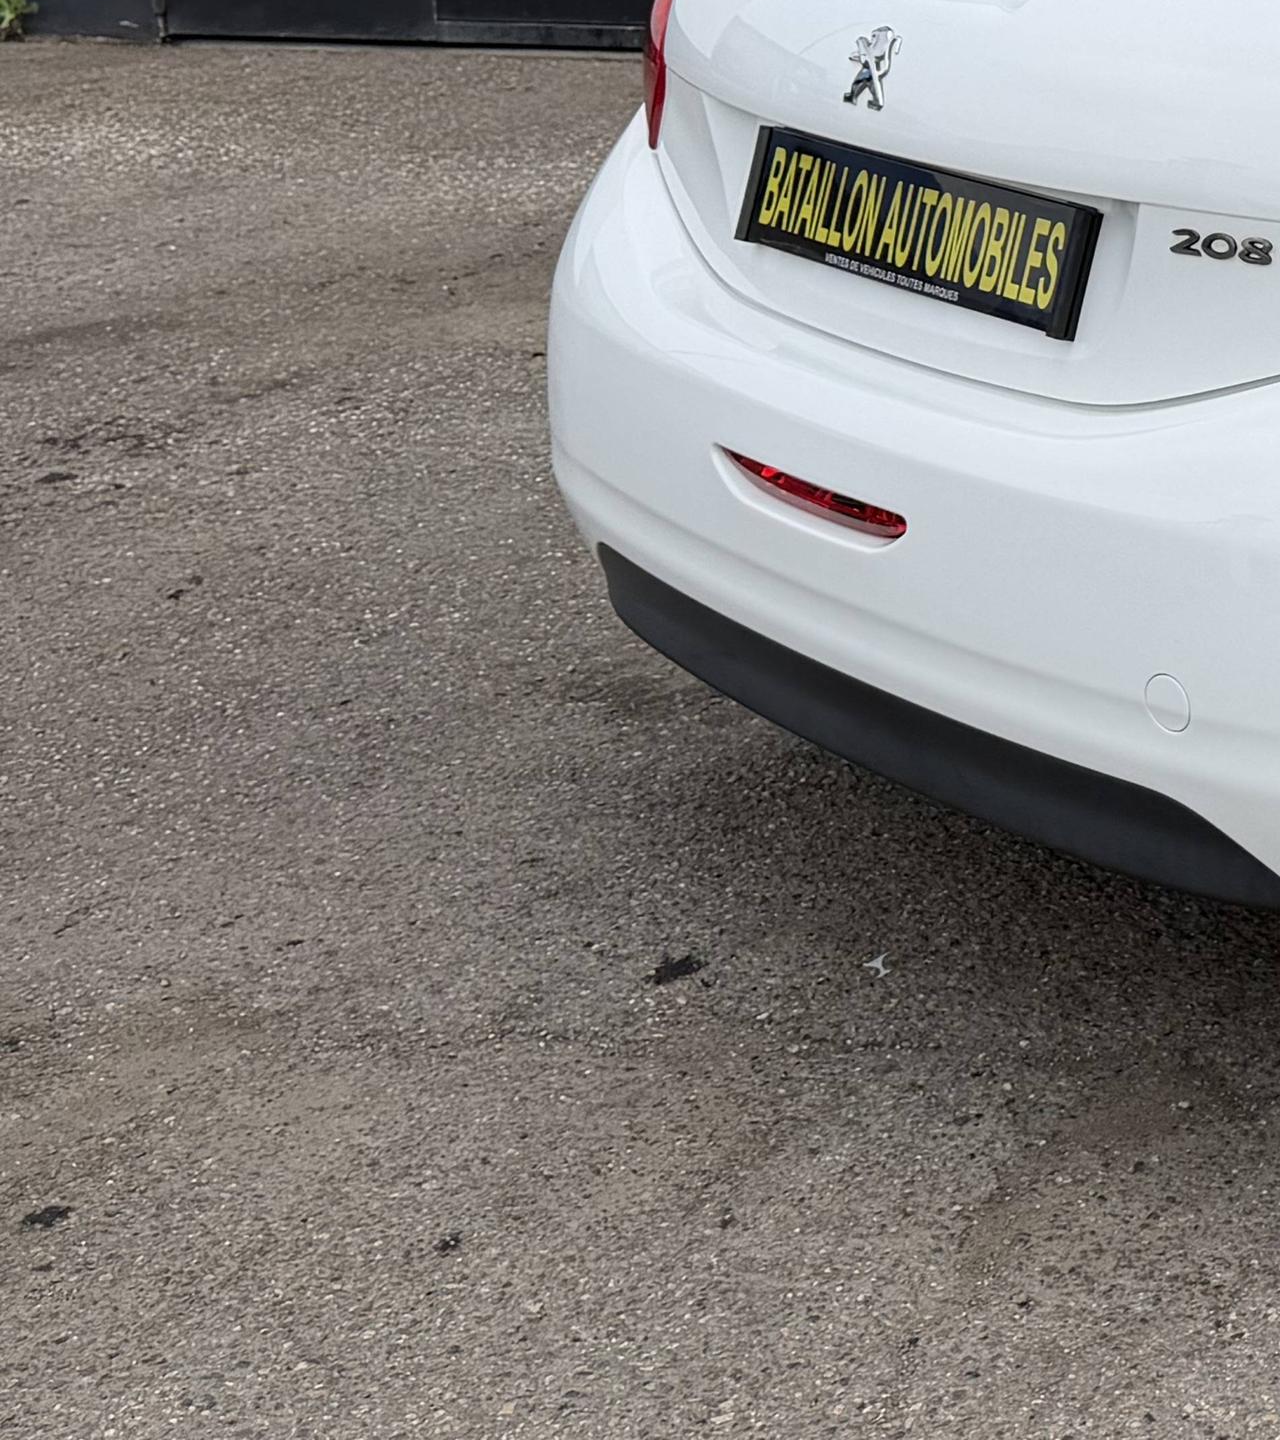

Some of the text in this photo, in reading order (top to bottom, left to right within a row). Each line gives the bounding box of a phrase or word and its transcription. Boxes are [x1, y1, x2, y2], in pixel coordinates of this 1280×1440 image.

[758, 146, 1068, 311] BATAILLON AUTOMOBILES
[1168, 226, 1275, 266] 208
[825, 252, 850, 268] VENTES
[849, 260, 860, 272] DE
[896, 274, 923, 291] TOUTES
[923, 282, 960, 302] MARQUES
